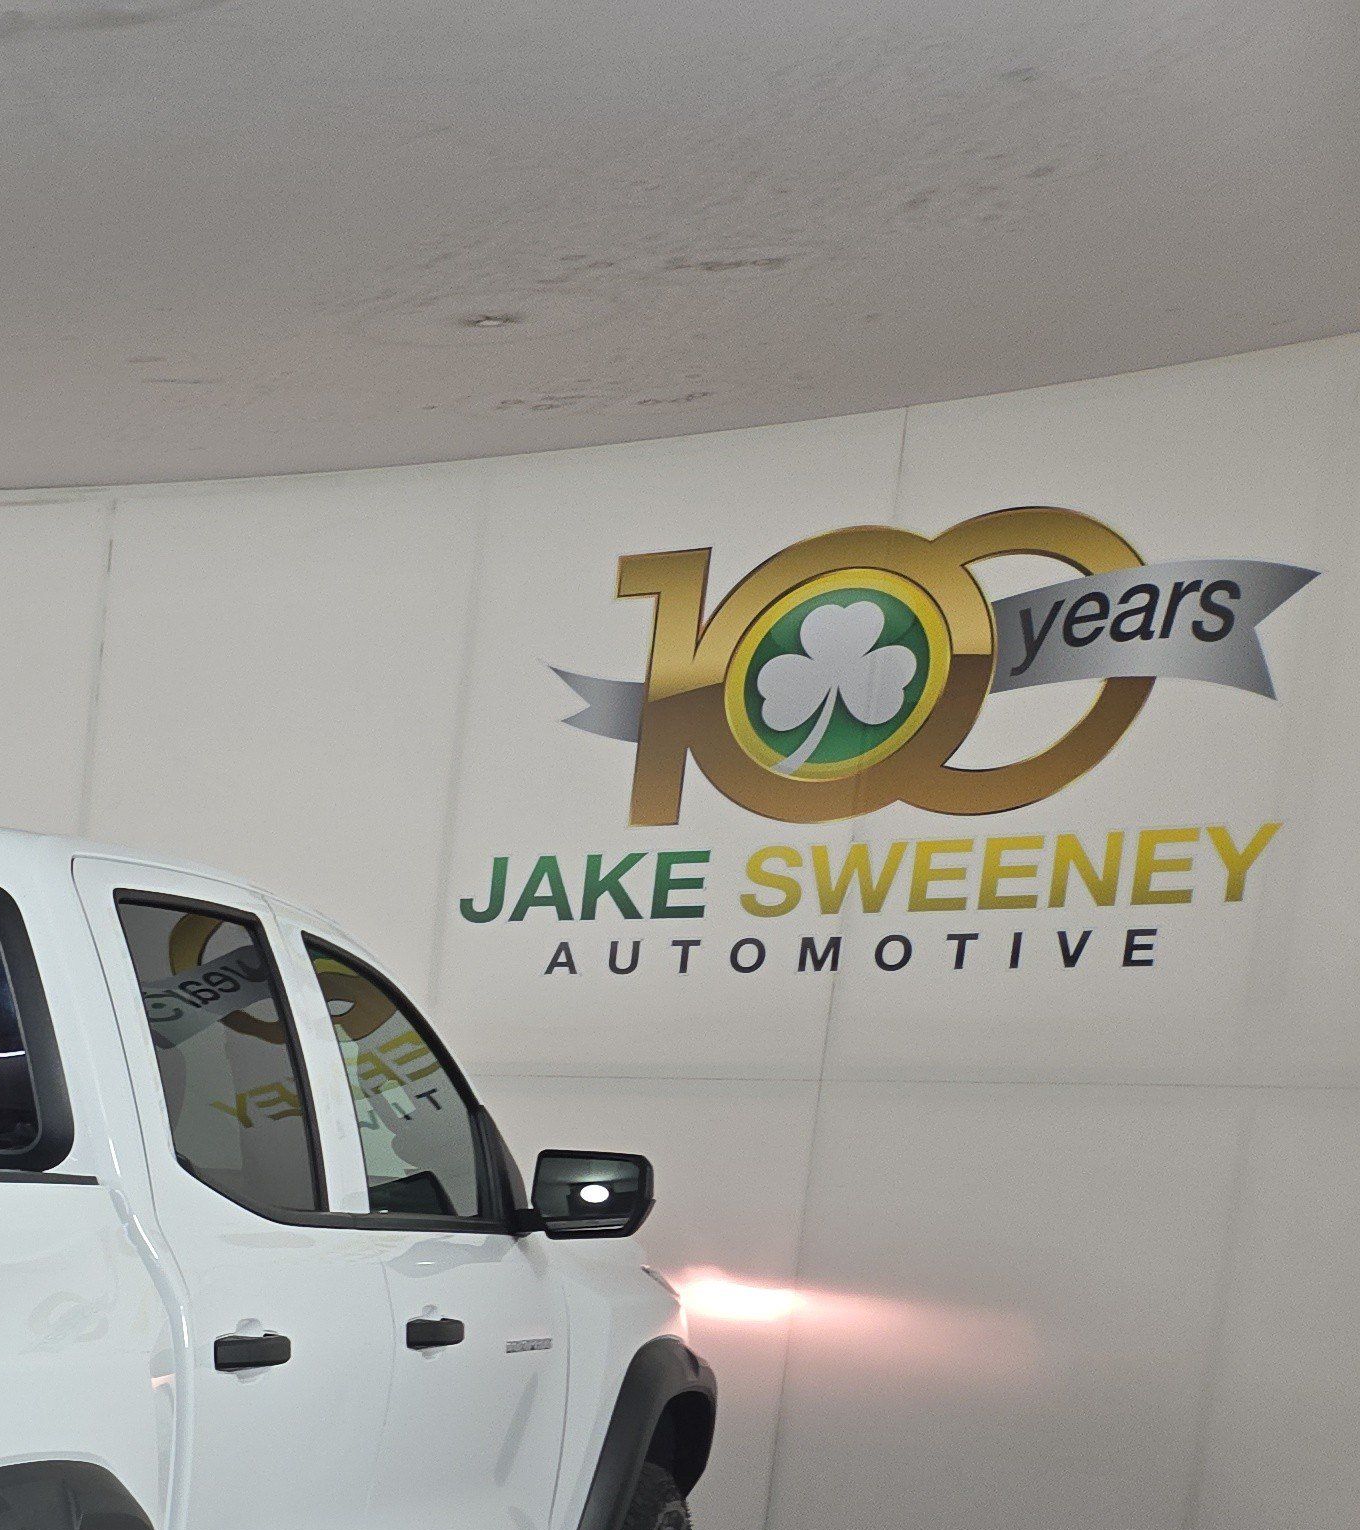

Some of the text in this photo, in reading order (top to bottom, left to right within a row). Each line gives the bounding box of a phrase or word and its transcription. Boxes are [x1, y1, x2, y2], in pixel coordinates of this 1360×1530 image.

[1009, 576, 1242, 676] years
[459, 822, 1281, 924] JAKE SWEENEY
[544, 928, 1160, 977] AUTOMOTIVE
